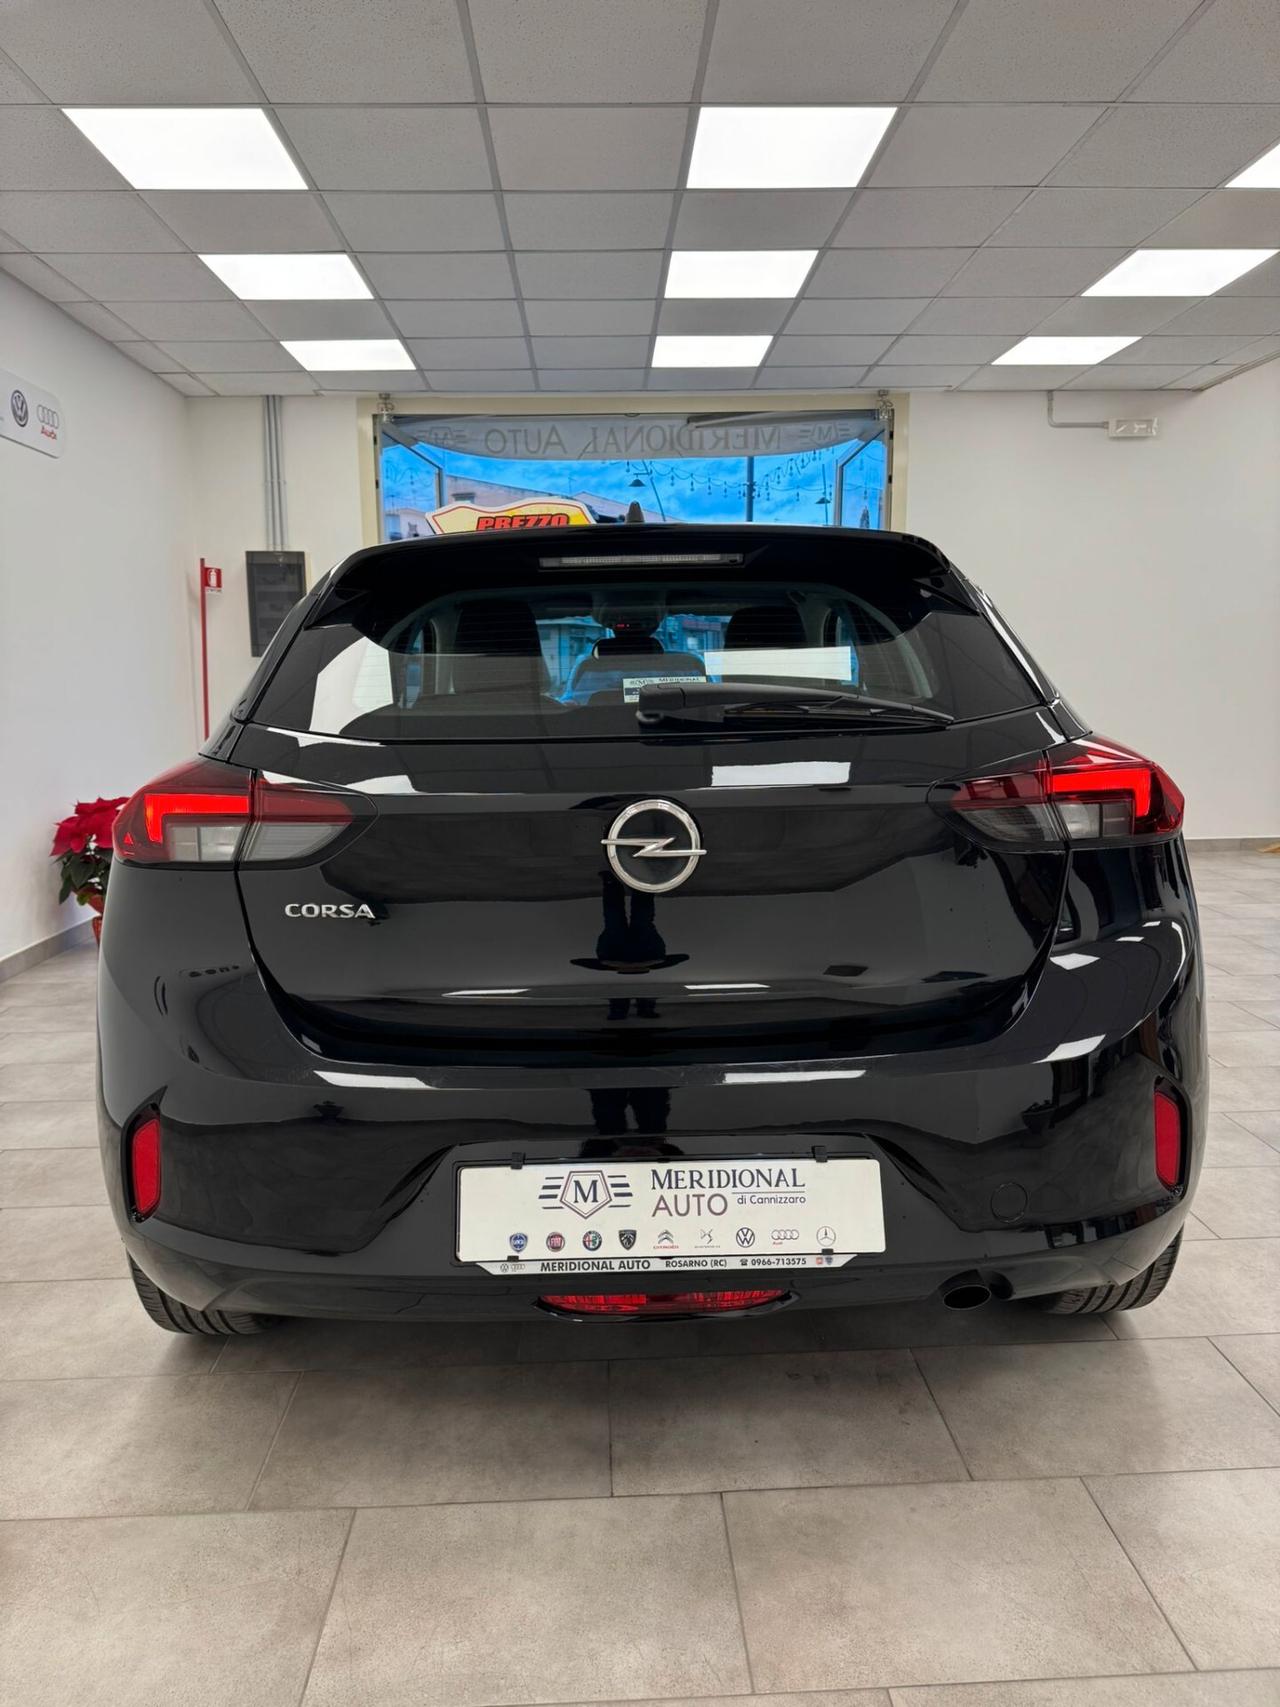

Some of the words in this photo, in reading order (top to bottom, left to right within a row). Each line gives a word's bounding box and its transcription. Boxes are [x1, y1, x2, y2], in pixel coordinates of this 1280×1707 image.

[477, 512, 569, 531] PREZZO
[284, 903, 375, 919] CORSA
[651, 1168, 806, 1190] MERIDIONAL
[573, 1179, 599, 1203] M
[651, 1193, 729, 1218] AUTO
[737, 1195, 747, 1205] di
[749, 1194, 807, 1205] Cannizzaro
[540, 1260, 615, 1272] MERIDIONAL
[618, 1259, 650, 1271] AUTO
[665, 1258, 708, 1268] ROSARNO
[710, 1258, 727, 1268] (RC)
[751, 1257, 807, 1266] 0966-713575
